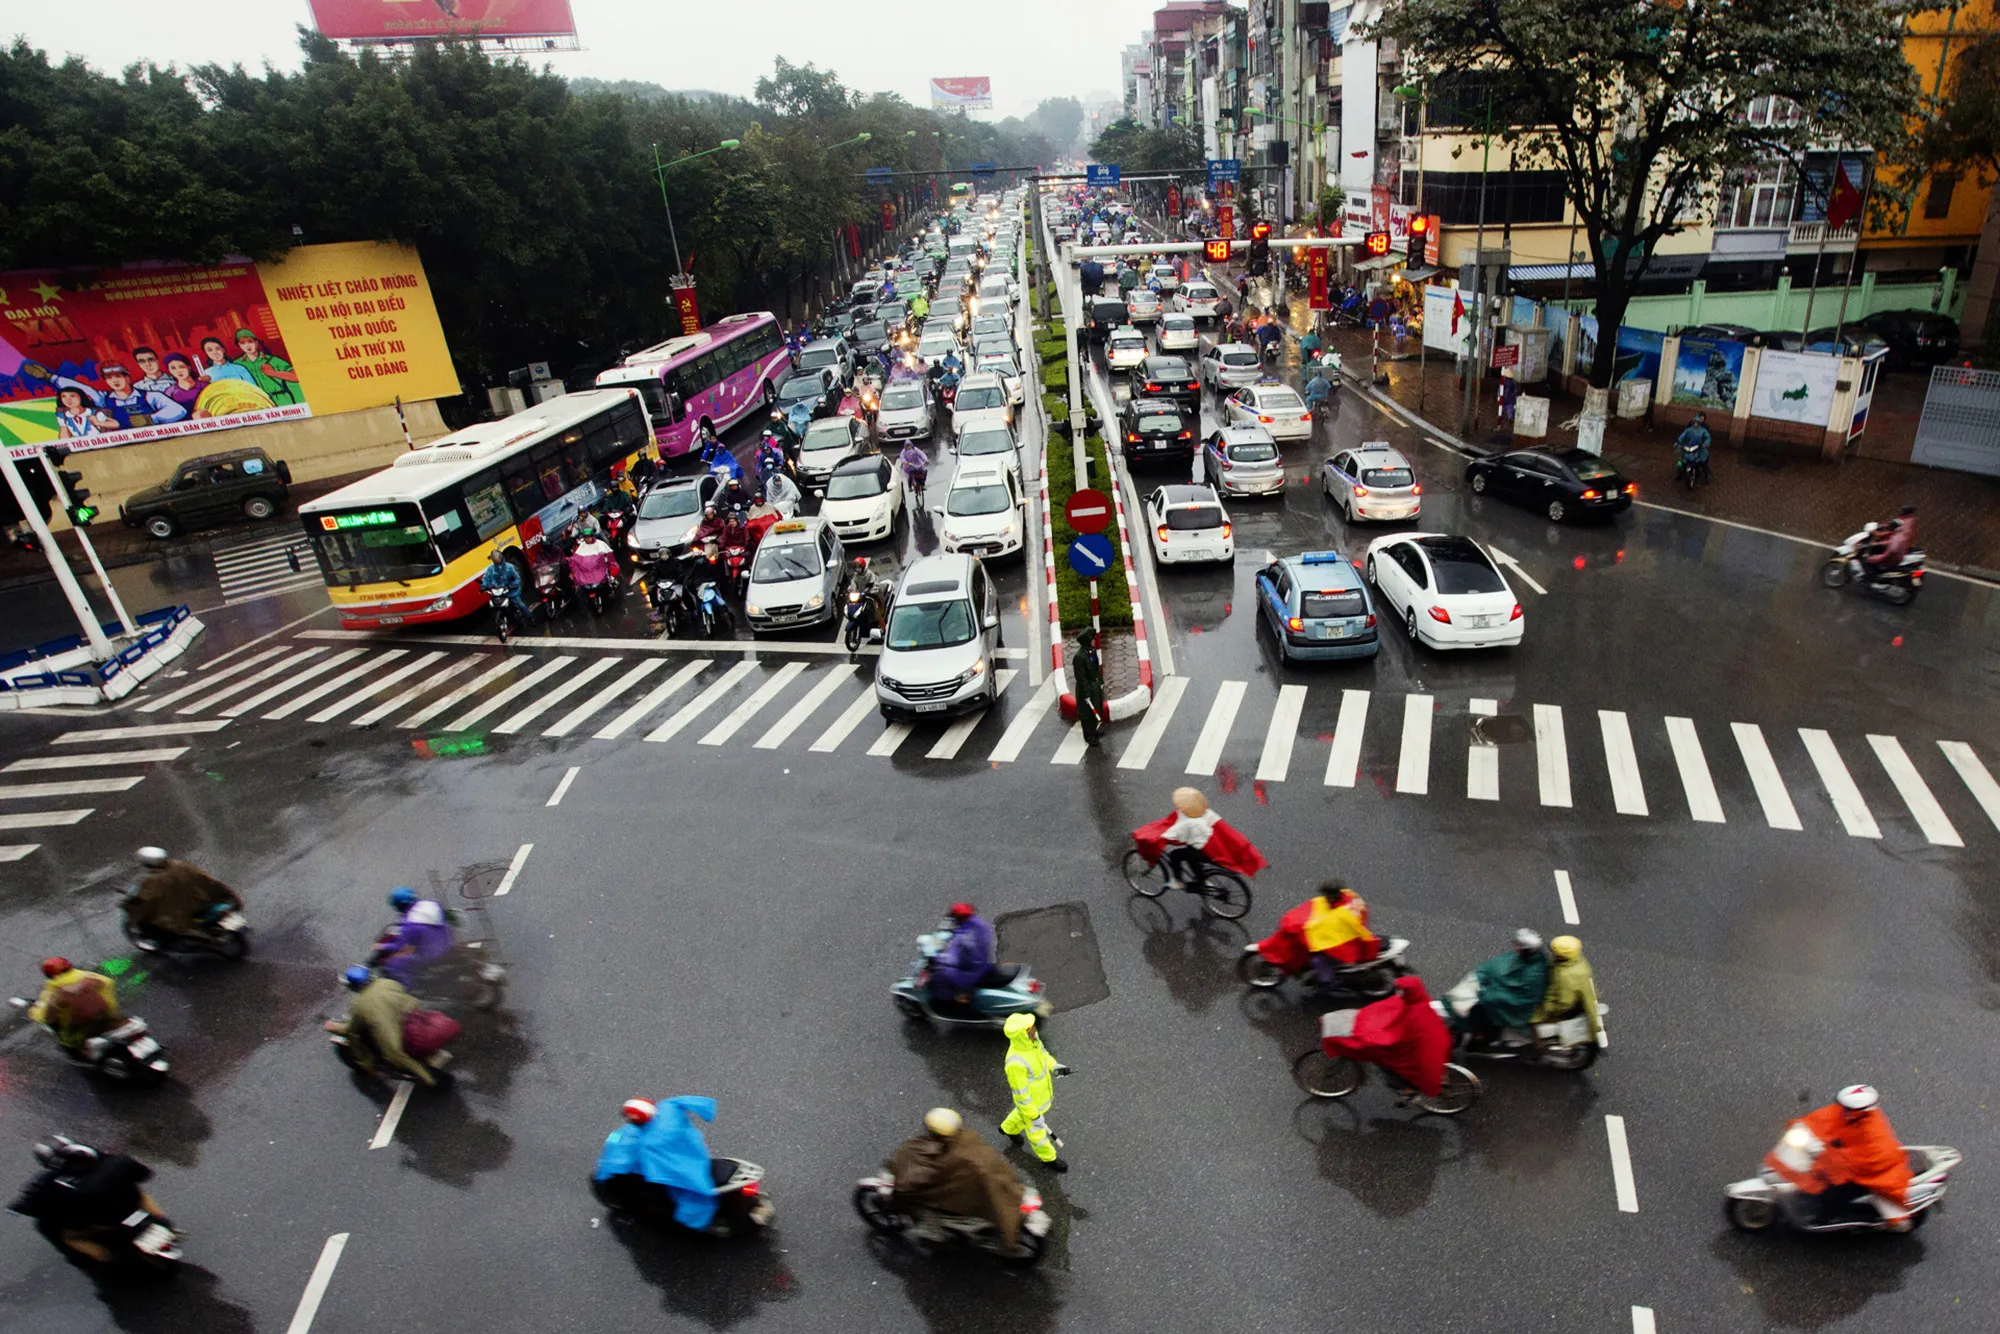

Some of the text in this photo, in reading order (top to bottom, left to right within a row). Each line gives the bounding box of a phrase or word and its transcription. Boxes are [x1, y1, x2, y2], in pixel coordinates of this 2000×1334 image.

[1368, 235, 1387, 252] 48
[276, 272, 418, 302] NHIỆT LIỆT CHÀO MỪNG
[4, 308, 32, 321] ĐẠI
[305, 292, 406, 322] ĐẠI HỘI ĐẠI BIỂU
[11, 317, 84, 347] XII
[328, 316, 398, 339] TOÀN QUỐC
[335, 338, 406, 360] LẦN THỨ XII
[347, 357, 409, 380] CỦA ĐẢNG
[220, 416, 242, 427] CÔNG
